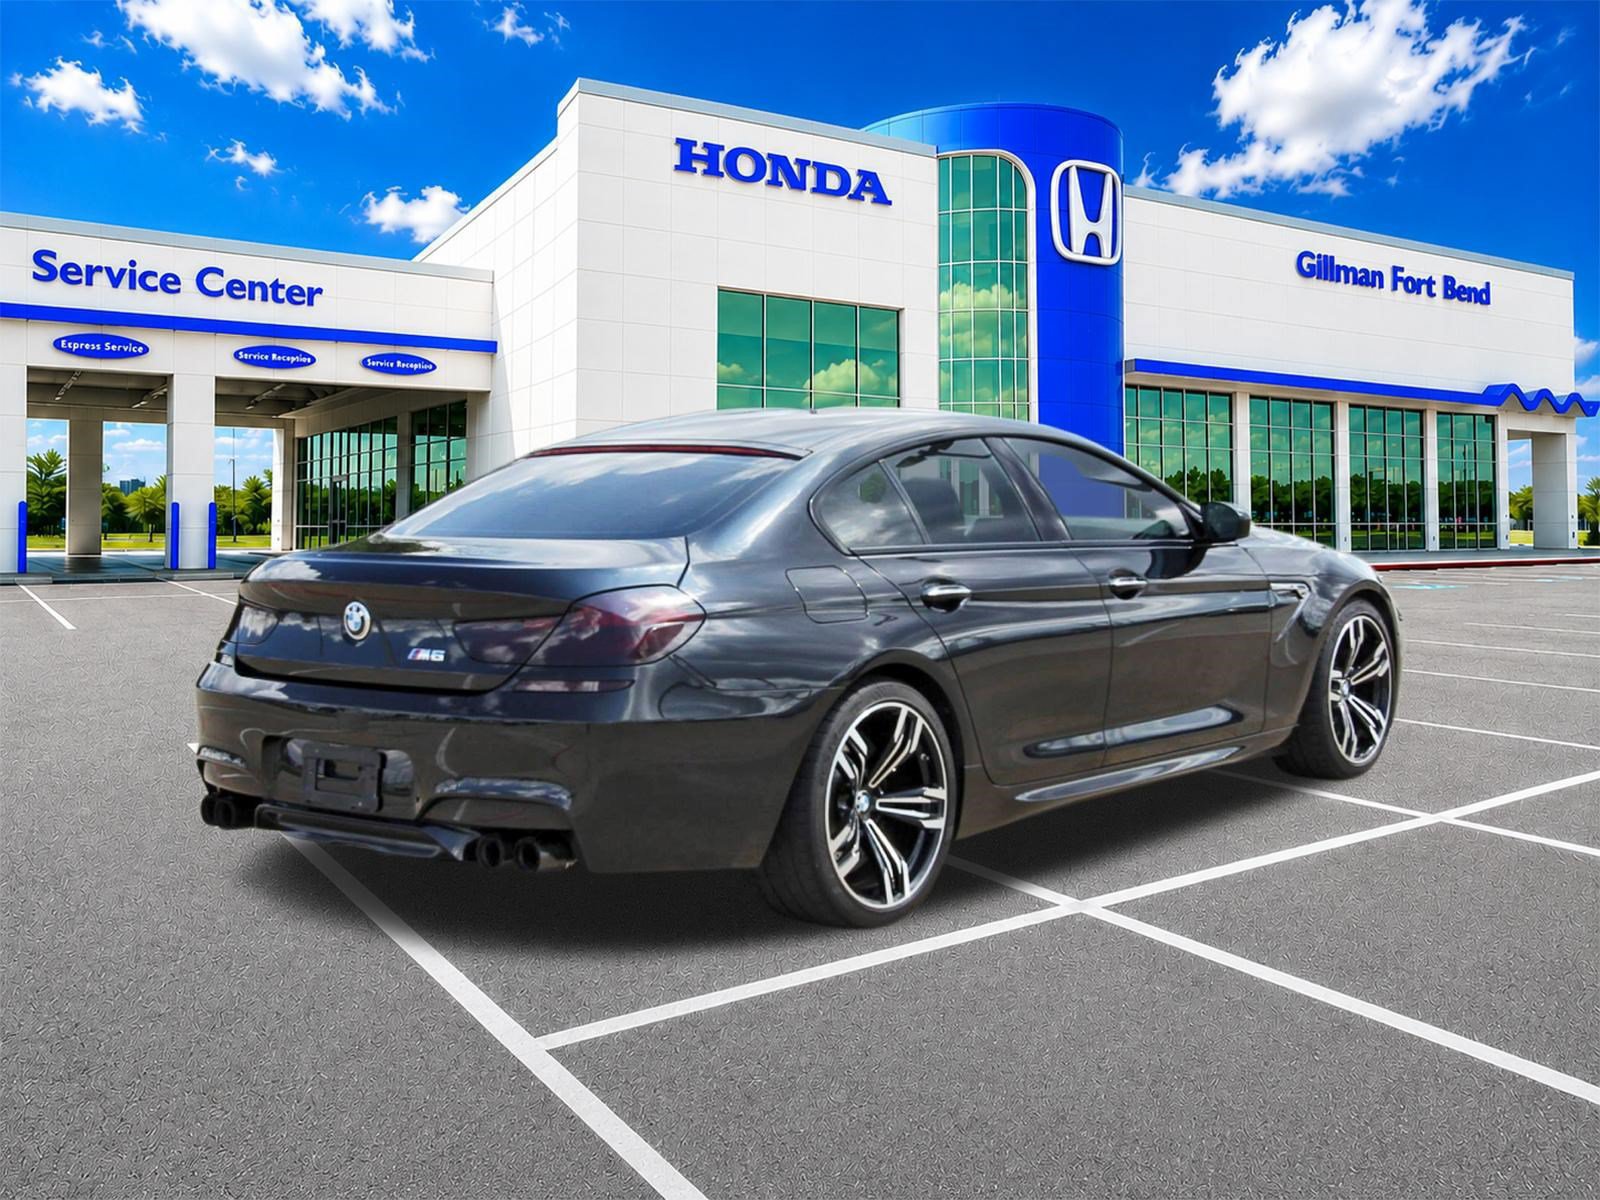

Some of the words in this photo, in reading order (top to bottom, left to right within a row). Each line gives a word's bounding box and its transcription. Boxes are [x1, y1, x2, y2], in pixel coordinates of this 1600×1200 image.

[674, 137, 892, 206] HONDA
[32, 249, 181, 294] Service
[196, 266, 323, 306] Center
[1296, 251, 1384, 289] Gillman
[1391, 265, 1436, 298] Fort
[1443, 275, 1490, 305] Bend
[104, 342, 143, 353] Service
[238, 351, 269, 361] Service
[407, 647, 446, 662] M6
